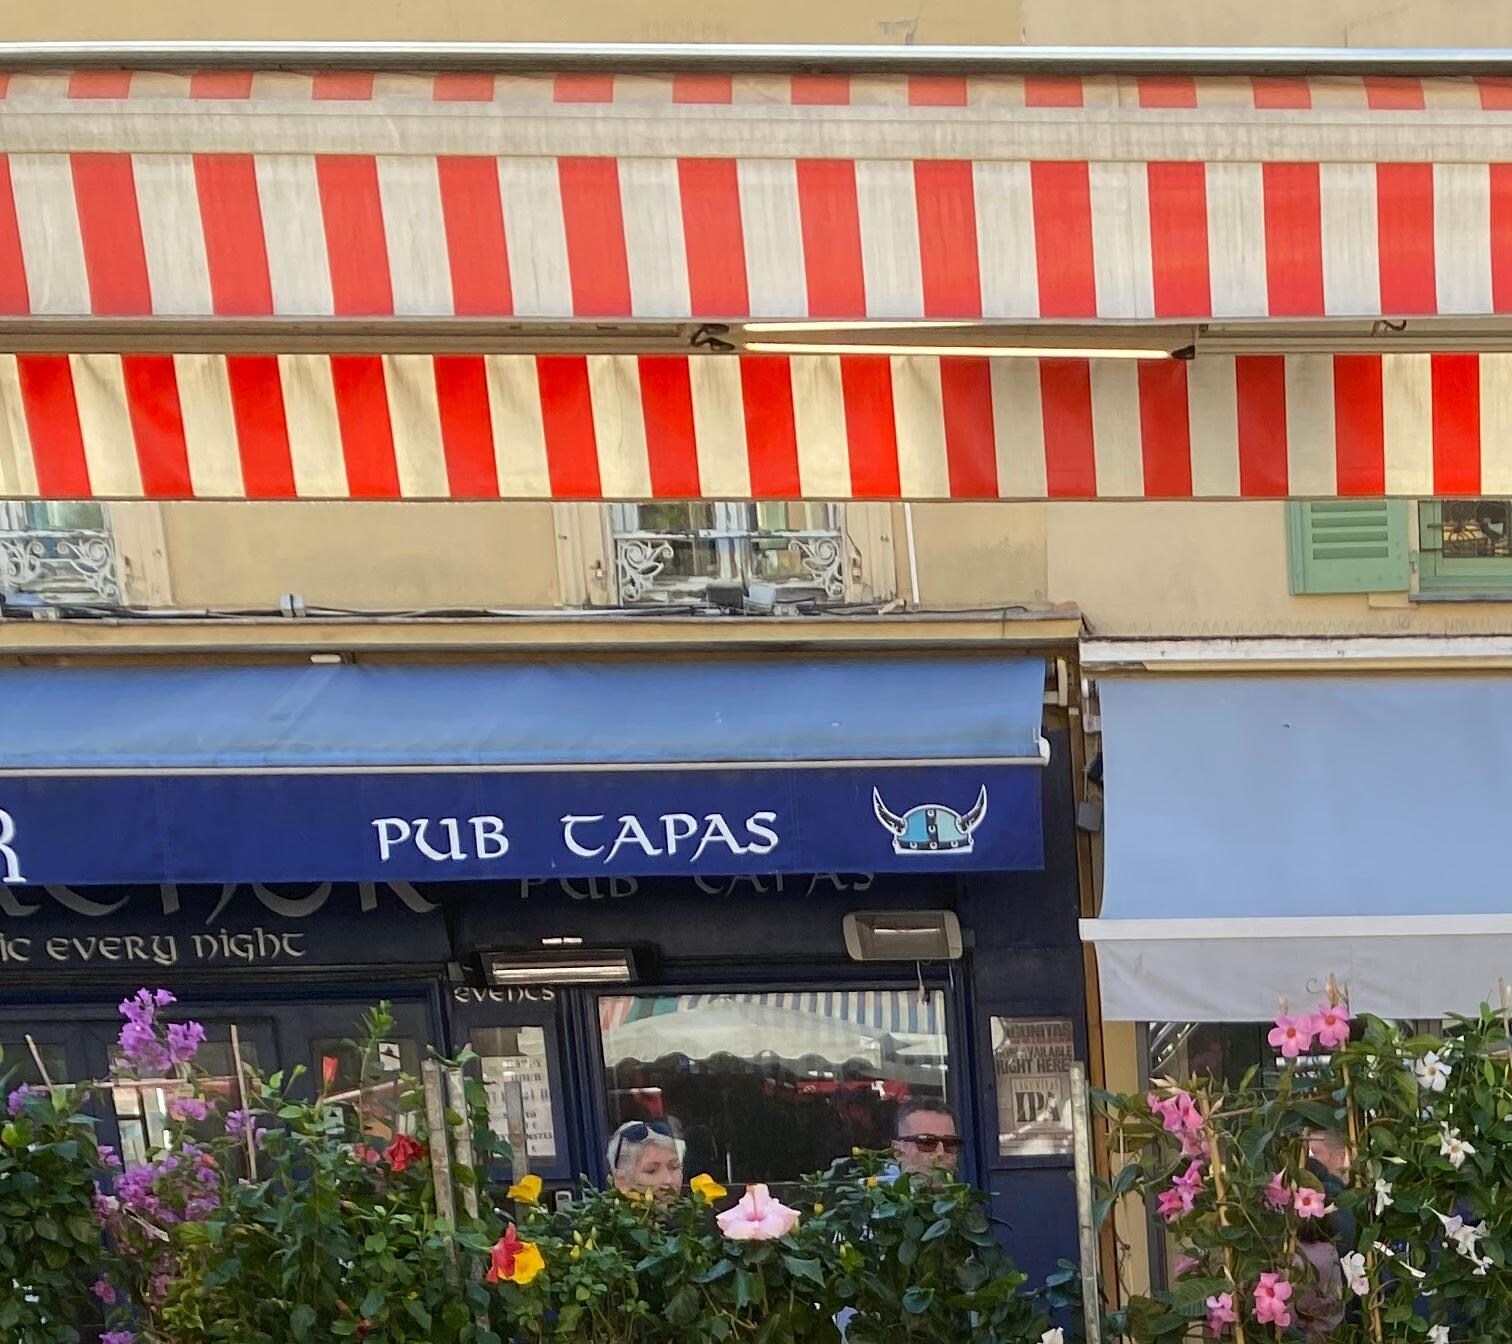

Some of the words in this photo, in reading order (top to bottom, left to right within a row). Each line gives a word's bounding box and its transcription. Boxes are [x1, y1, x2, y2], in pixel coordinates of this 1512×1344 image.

[371, 814, 509, 862] PUB
[560, 811, 780, 864] TAPAS
[1015, 1091, 1062, 1123] IPA
